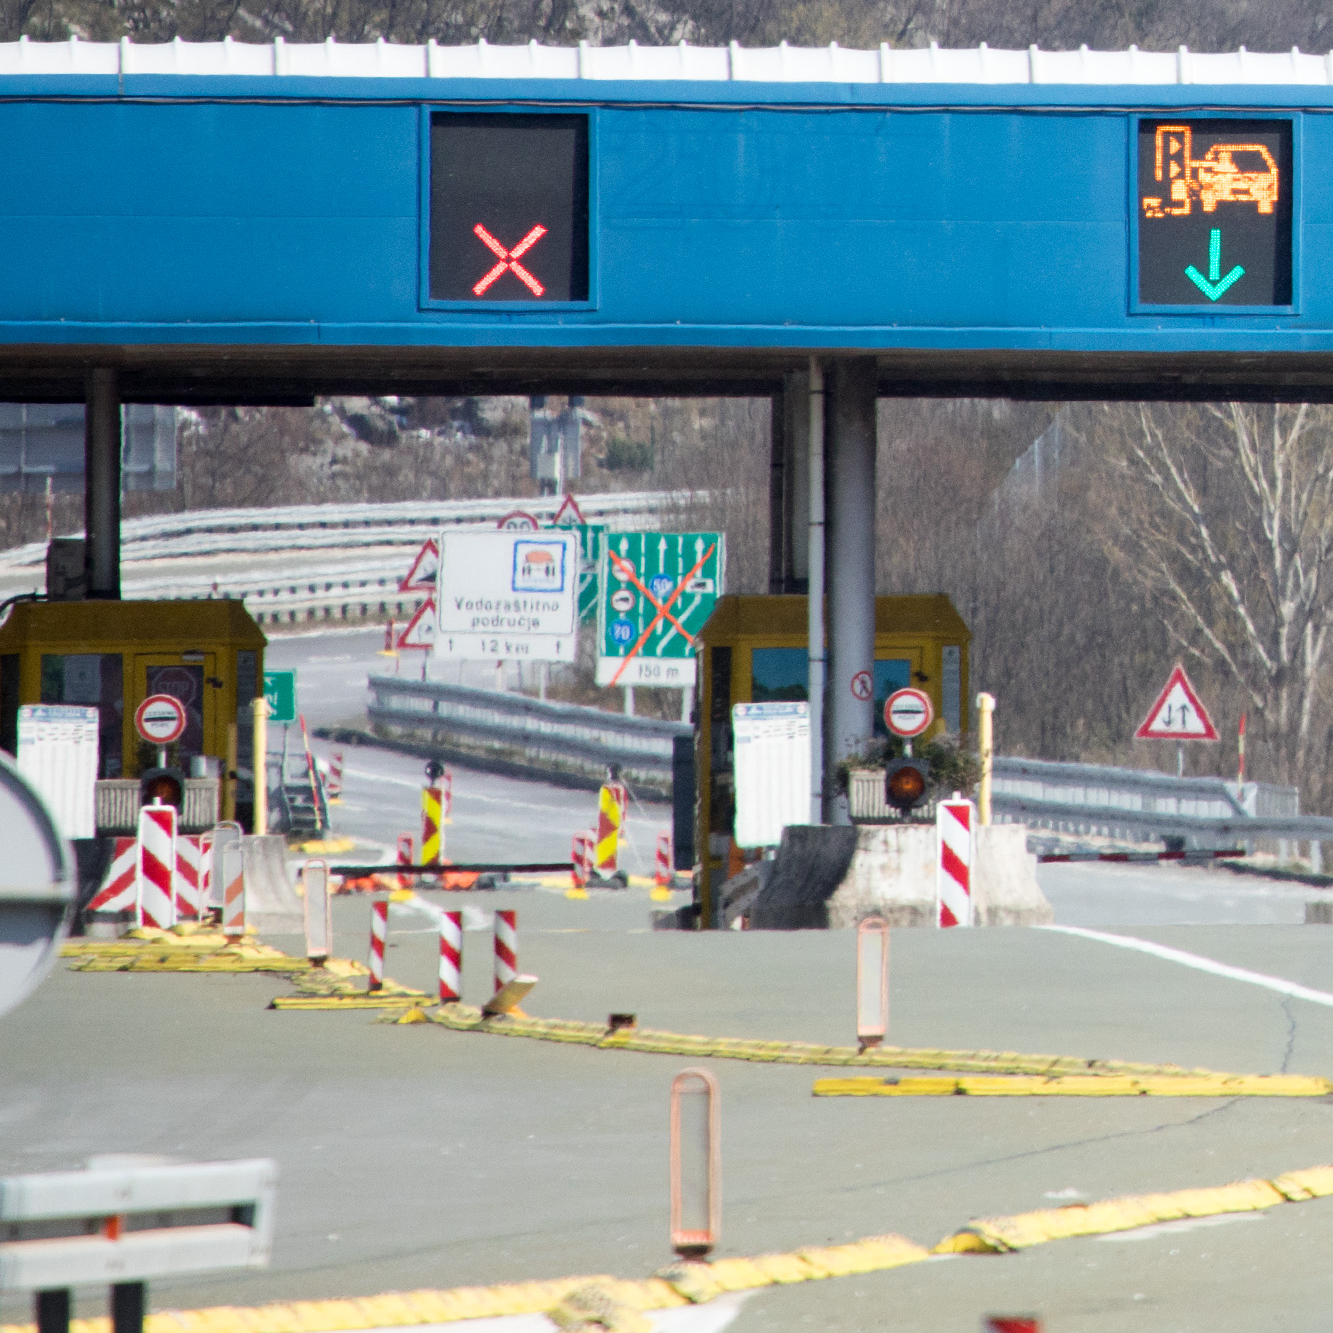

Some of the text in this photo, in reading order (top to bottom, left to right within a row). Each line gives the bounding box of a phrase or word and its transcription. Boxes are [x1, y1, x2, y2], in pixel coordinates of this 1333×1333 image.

[454, 596, 560, 612] Vodozaštitno
[482, 639, 530, 654] 12 km
[638, 666, 679, 678] 150 m
